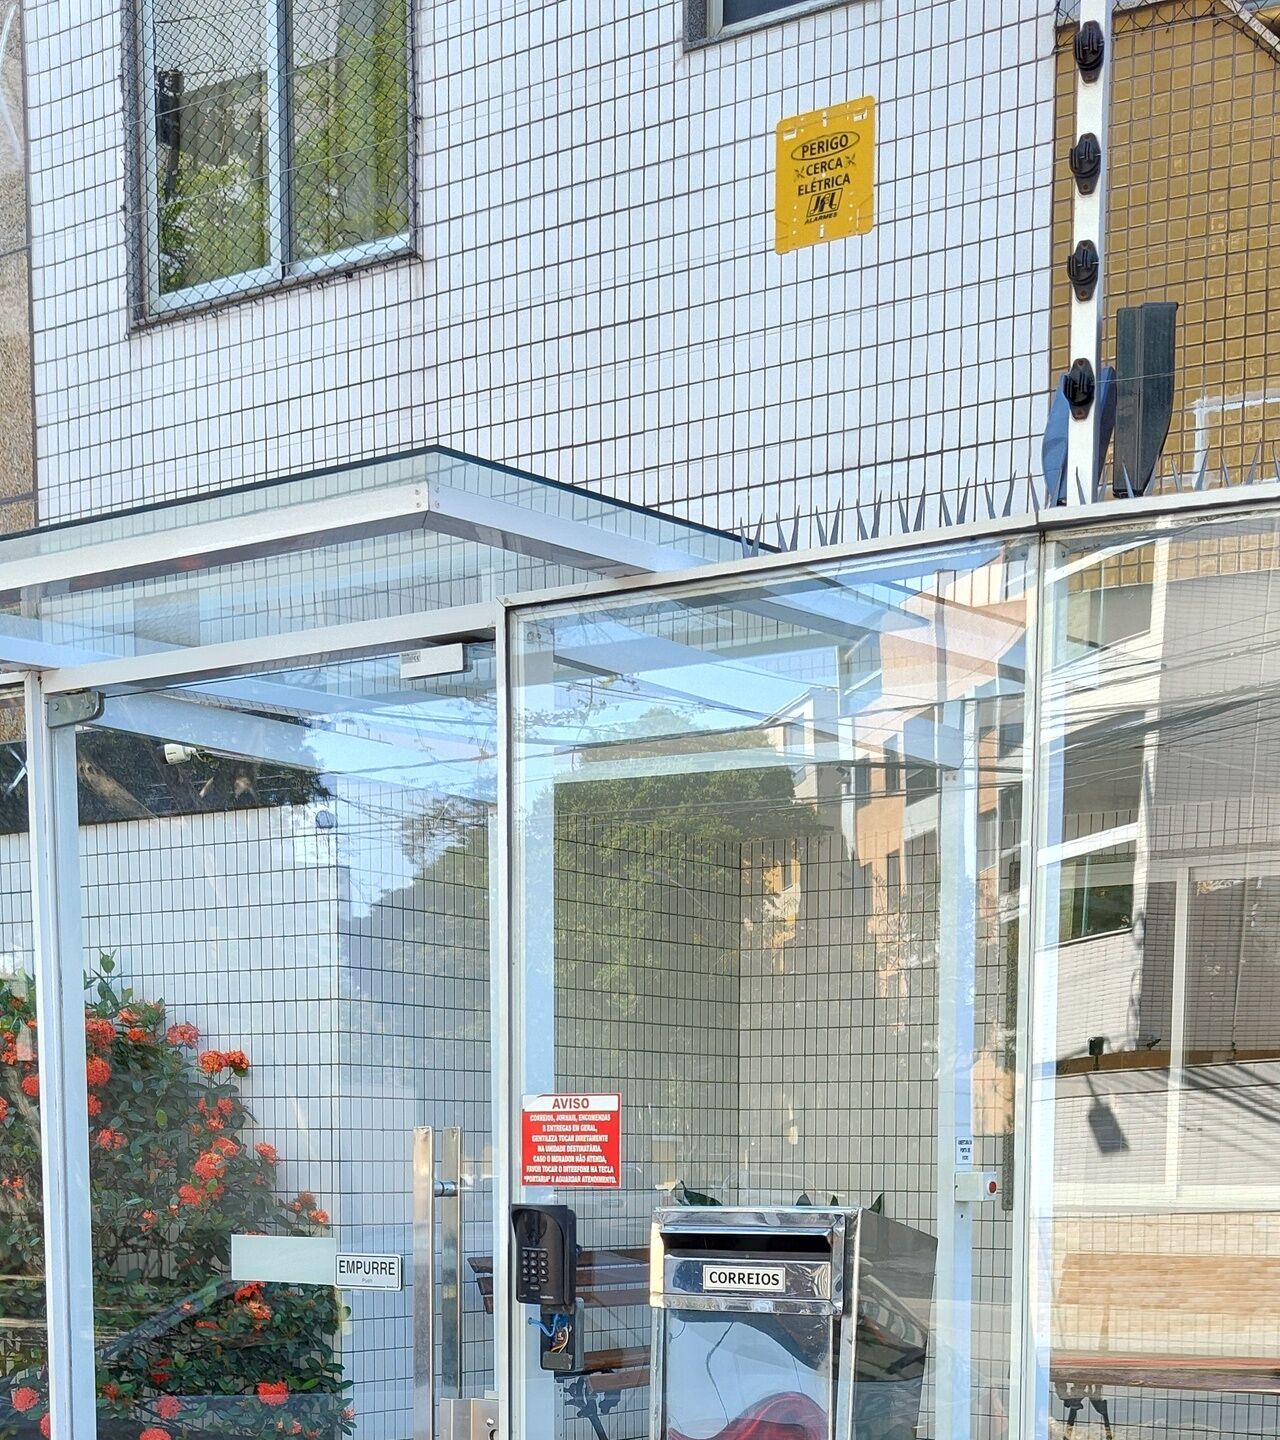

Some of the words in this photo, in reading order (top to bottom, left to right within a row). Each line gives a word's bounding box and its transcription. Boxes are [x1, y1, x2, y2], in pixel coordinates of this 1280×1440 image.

[801, 134, 849, 158] PERIGO
[806, 157, 843, 176] CERCA
[797, 173, 851, 197] ELÉTRICA
[804, 212, 838, 225] ALARMES
[552, 1098, 590, 1109] AVISO
[338, 1260, 396, 1276] EMPURRE
[709, 1271, 780, 1286] CORREIOS
